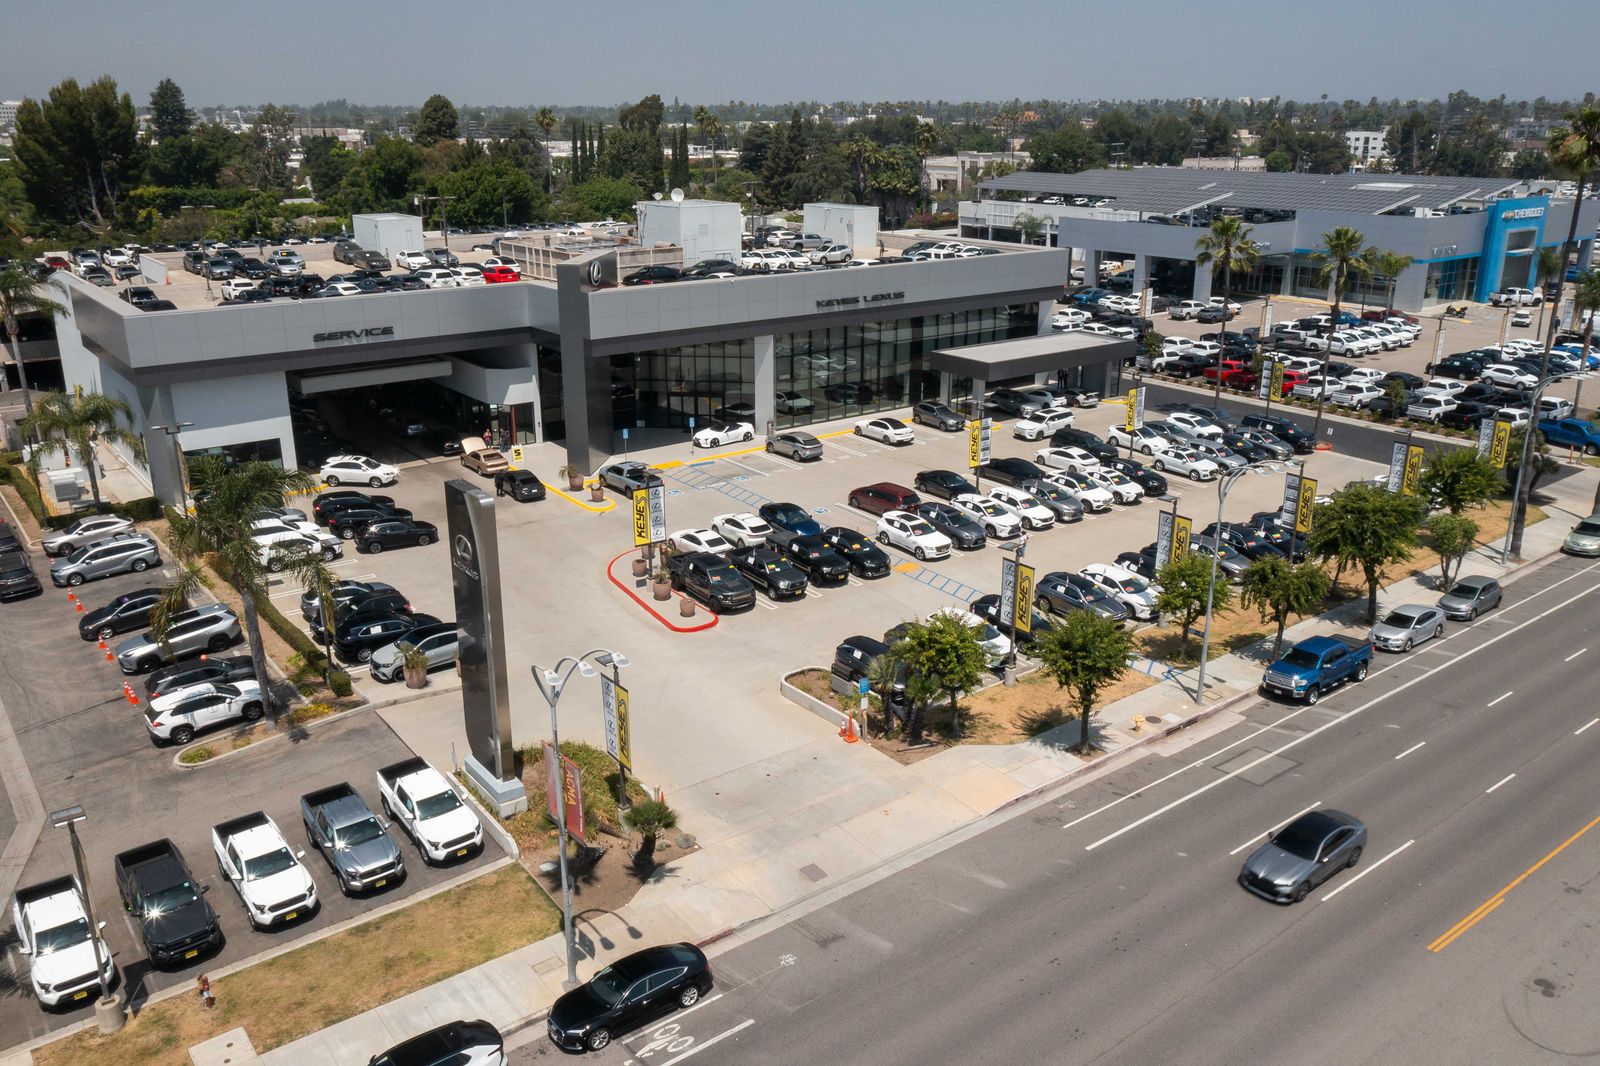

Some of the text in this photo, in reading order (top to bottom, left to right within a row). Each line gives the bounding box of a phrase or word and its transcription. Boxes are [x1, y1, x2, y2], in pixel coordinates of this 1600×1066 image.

[816, 291, 905, 308] KEYES LEXUS
[313, 326, 395, 342] SERVICE
[514, 448, 522, 457] 5
[635, 494, 648, 539] KEYES
[1299, 483, 1314, 529] KEYES
[453, 557, 479, 581] LEXUS
[1017, 571, 1032, 630] KEYES
[566, 768, 577, 806] ACMA
